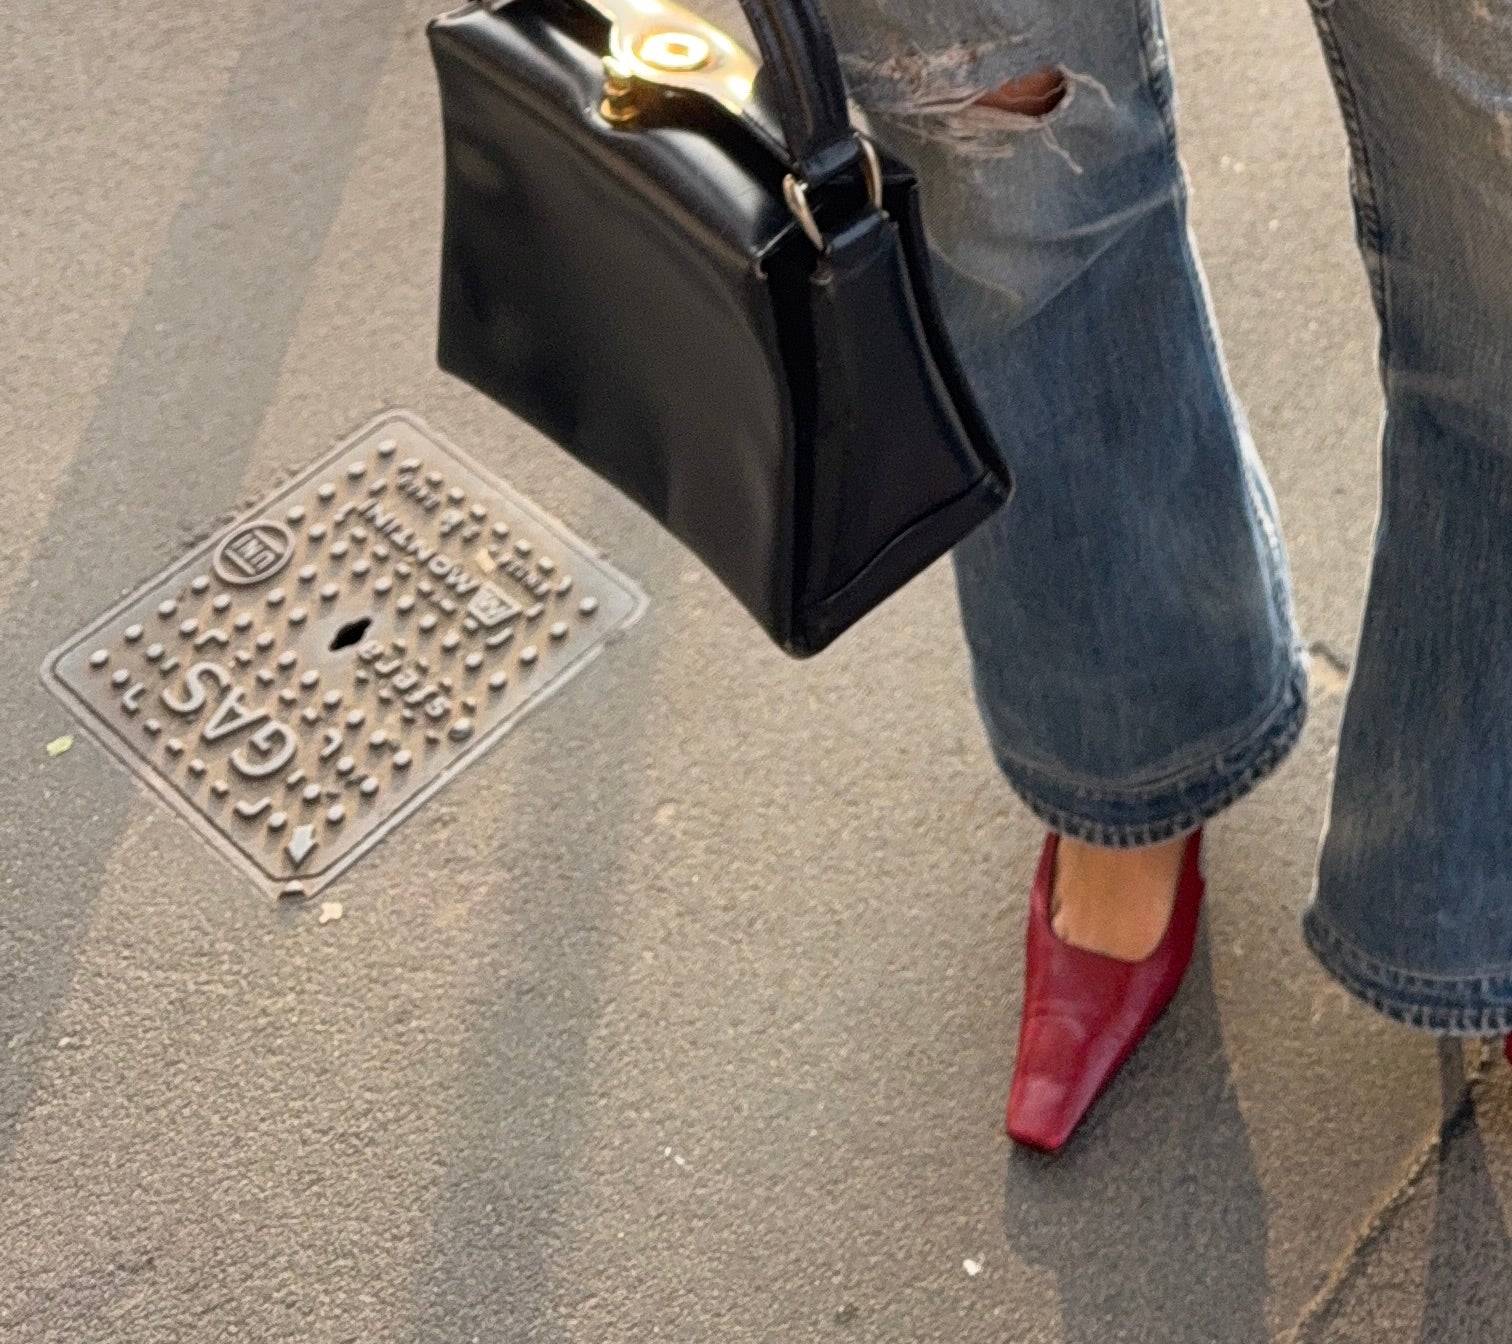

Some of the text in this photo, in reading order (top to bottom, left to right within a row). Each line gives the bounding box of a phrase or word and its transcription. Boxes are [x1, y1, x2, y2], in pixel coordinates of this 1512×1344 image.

[230, 533, 275, 571] UNI
[358, 639, 451, 717] sfera
[161, 662, 298, 776] GAS
